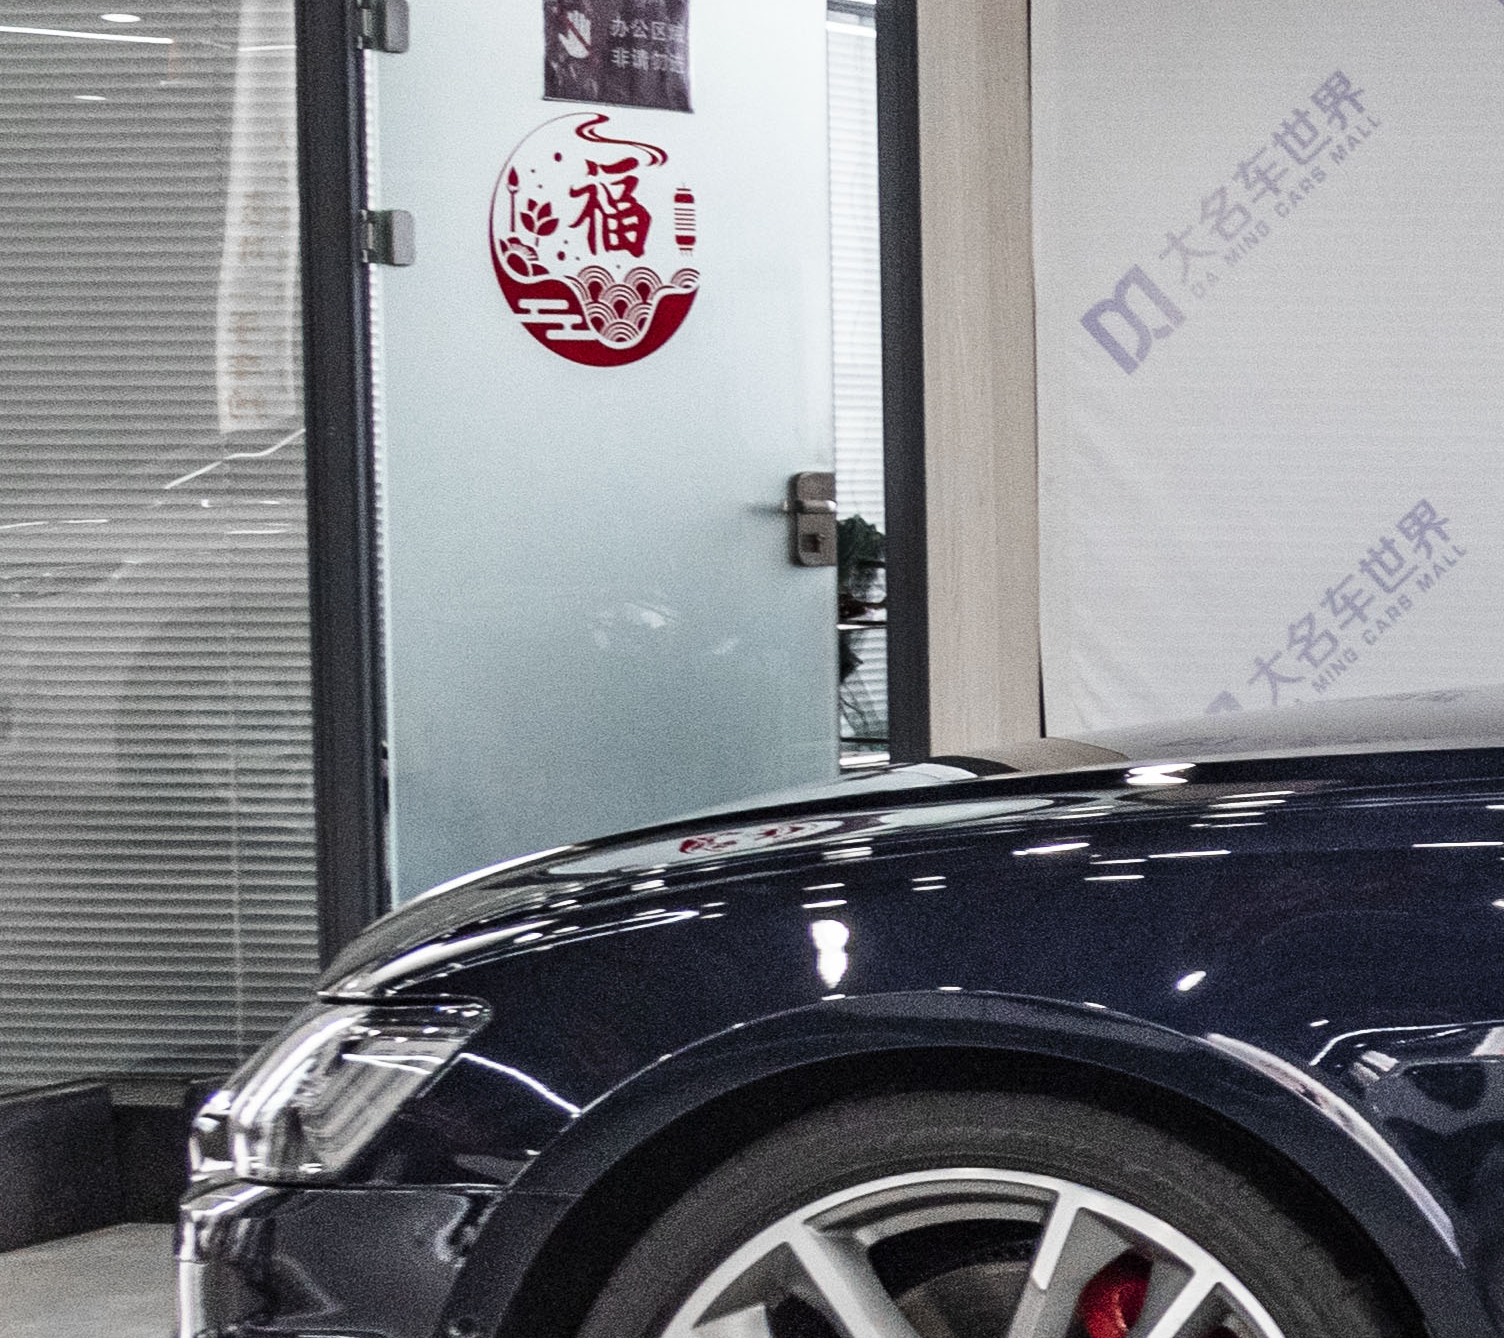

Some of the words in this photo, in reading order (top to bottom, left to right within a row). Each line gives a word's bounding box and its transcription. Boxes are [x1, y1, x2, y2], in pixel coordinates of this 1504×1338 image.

[569, 156, 652, 258] 福
[1158, 70, 1365, 286] 大名车世界
[1247, 499, 1450, 706] 大名车世界
